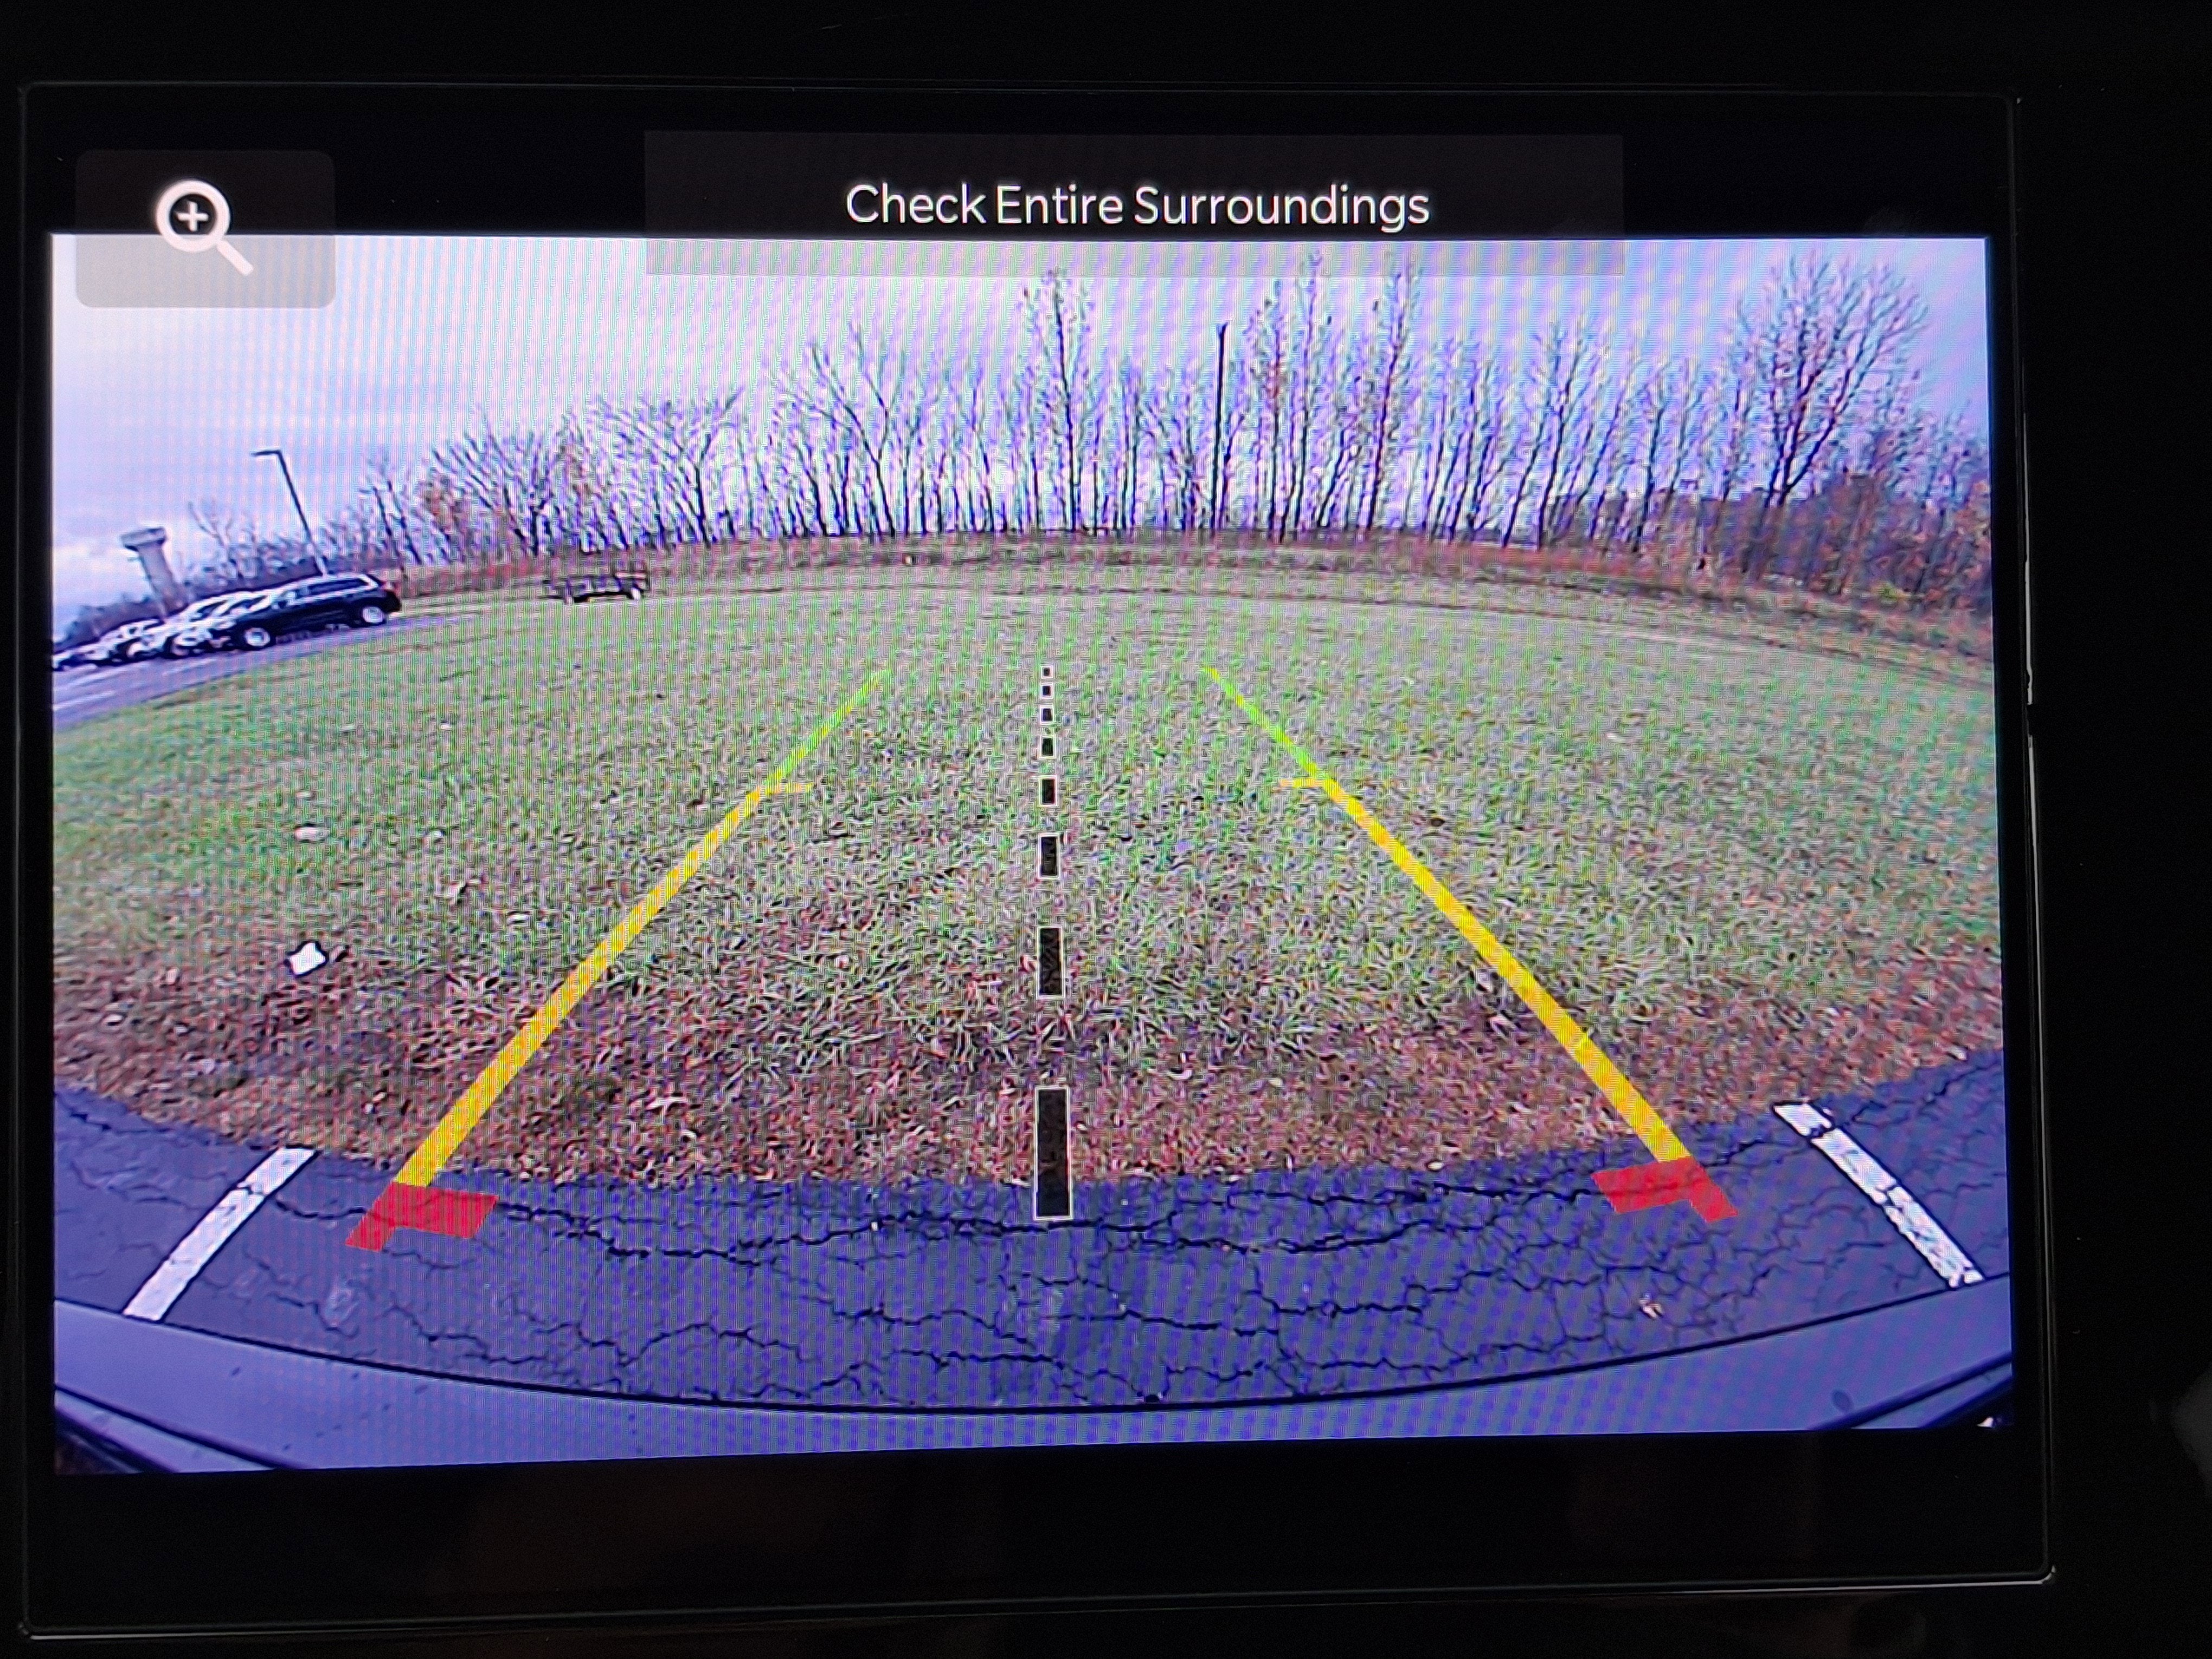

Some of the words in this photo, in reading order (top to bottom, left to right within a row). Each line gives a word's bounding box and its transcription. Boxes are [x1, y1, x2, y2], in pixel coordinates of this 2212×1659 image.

[846, 182, 986, 223] Check
[997, 184, 1123, 224] Entire
[1134, 184, 1430, 231] Surroundings
